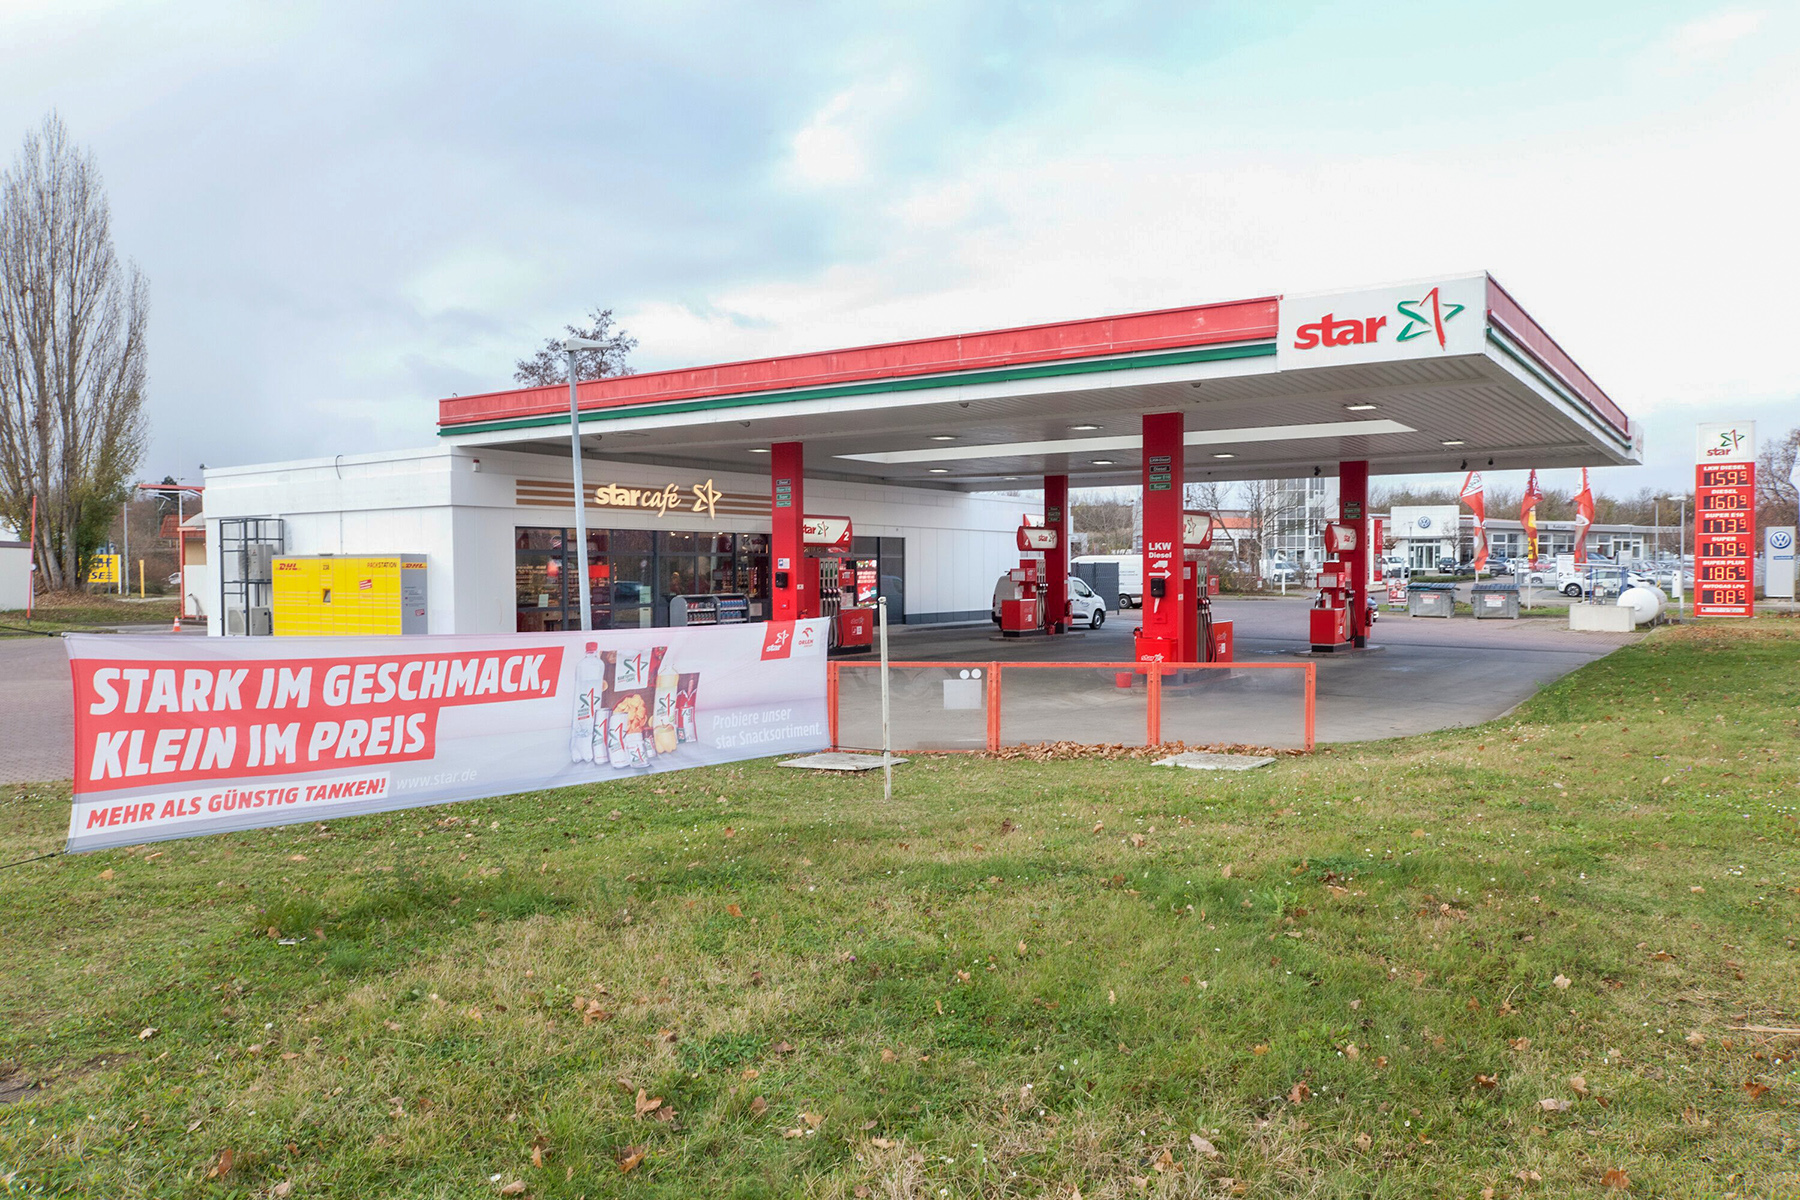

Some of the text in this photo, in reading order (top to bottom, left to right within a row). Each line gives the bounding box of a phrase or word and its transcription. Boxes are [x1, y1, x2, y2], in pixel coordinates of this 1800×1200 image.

[1294, 313, 1387, 350] star
[1706, 448, 1731, 456] star
[843, 532, 849, 541] 2
[1149, 542, 1172, 550] LKW
[766, 644, 781, 652] star
[89, 654, 550, 715] STARK IM GESCHMACK,
[713, 708, 792, 730] Probiere unser
[89, 713, 426, 780] KLEIN IM PREIS
[716, 722, 822, 749] star Snacksortiment.
[396, 768, 478, 790] www.star.de
[86, 778, 386, 829] MEHR ALS GÜNSTIG TANKEN!
